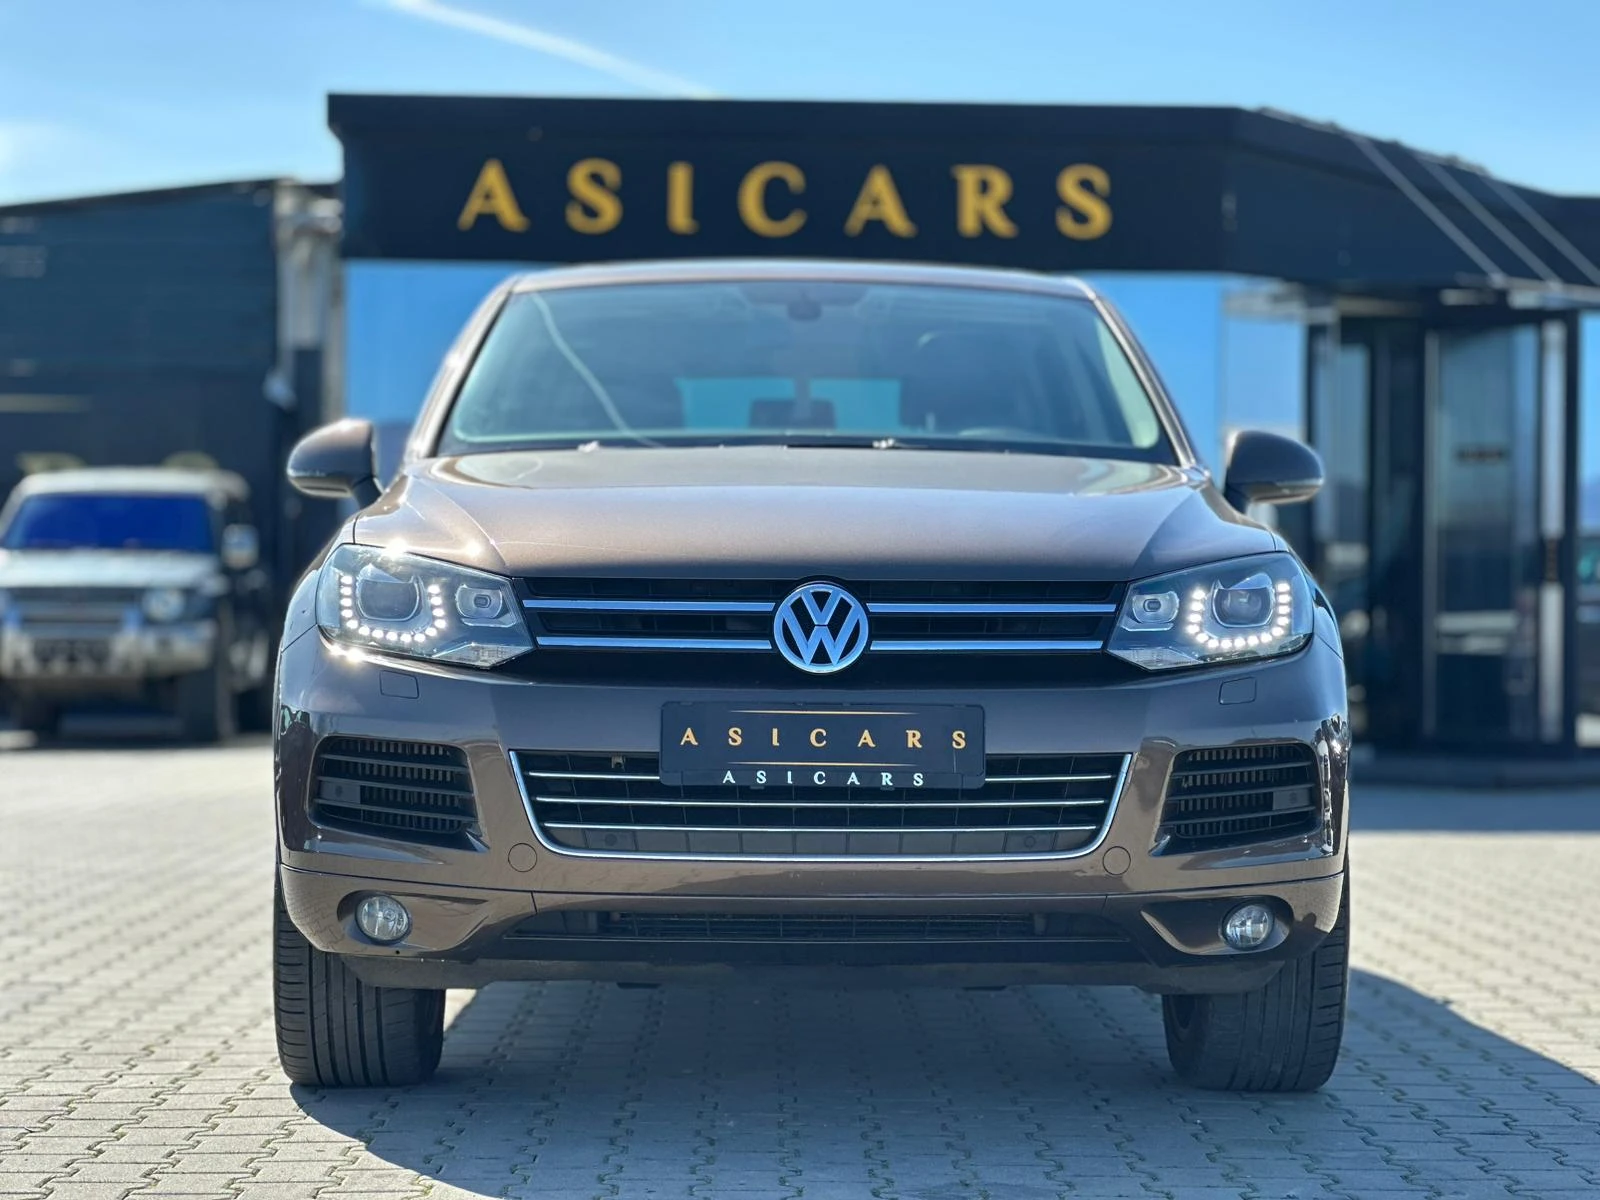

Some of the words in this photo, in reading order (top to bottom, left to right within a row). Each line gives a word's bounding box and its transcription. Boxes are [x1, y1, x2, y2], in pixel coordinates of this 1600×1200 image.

[456, 157, 1113, 240] ASICARS
[777, 582, 866, 671] VW
[679, 726, 967, 749] ASICARS
[722, 770, 924, 787] ASICARS
